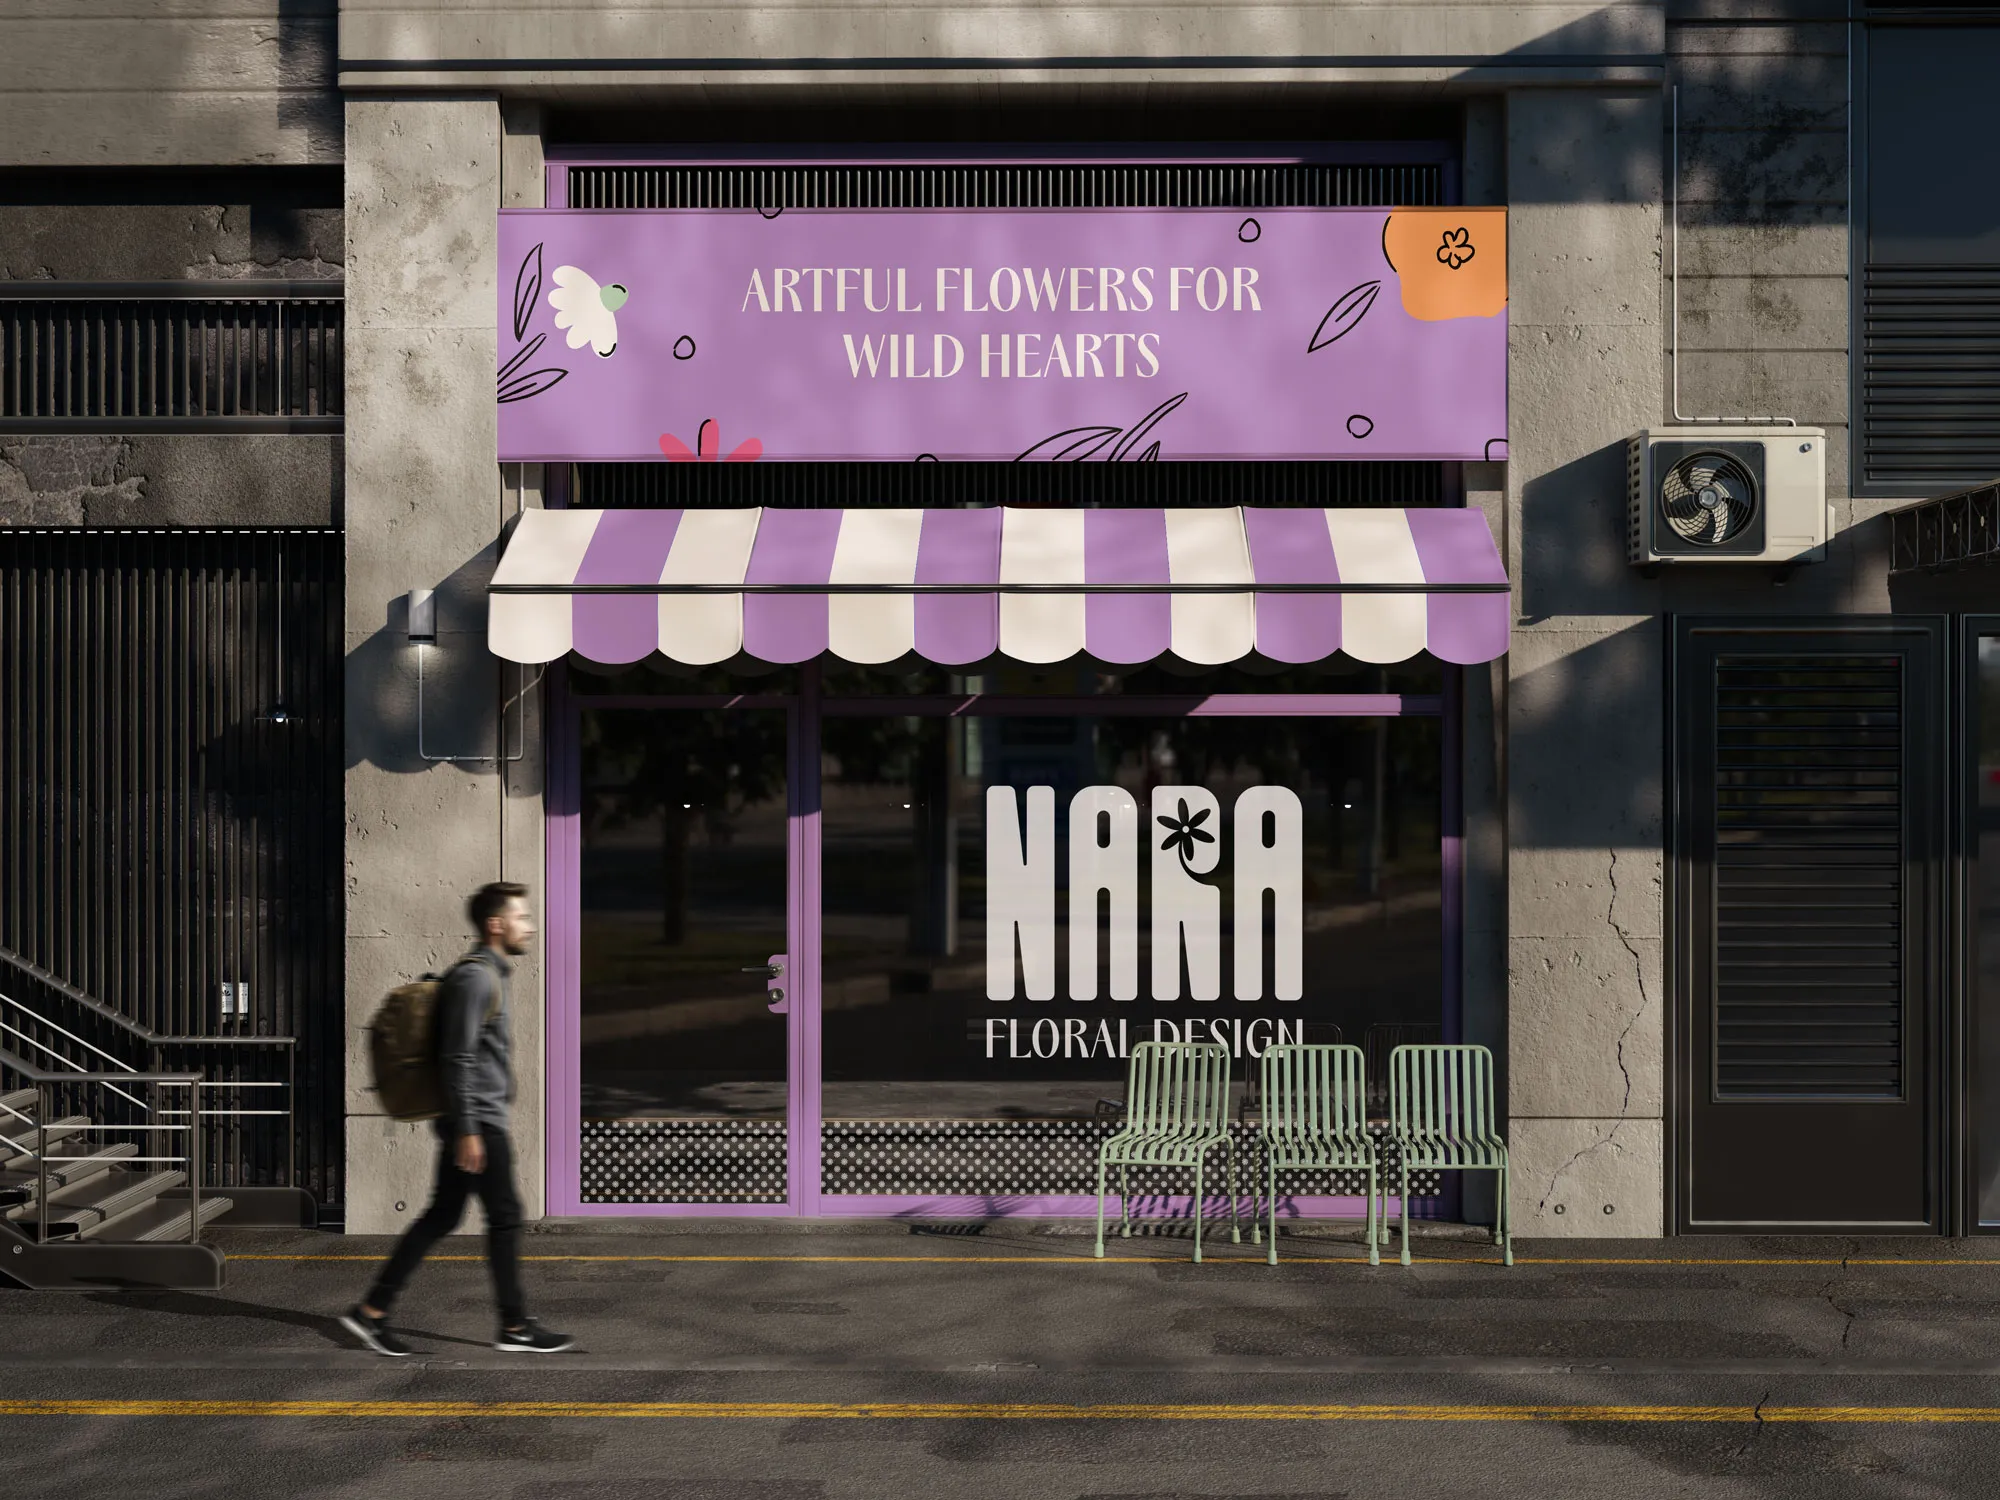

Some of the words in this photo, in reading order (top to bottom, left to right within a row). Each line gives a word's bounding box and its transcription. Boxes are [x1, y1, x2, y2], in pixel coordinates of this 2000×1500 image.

[742, 266, 922, 312] ARTFUL
[936, 266, 1155, 312] FLOWERS
[1170, 266, 1262, 312] FOR
[843, 333, 965, 378] WILD
[980, 332, 1160, 378] HEARTS
[986, 785, 1303, 1001] NARA
[986, 1018, 1140, 1059] FLORAL
